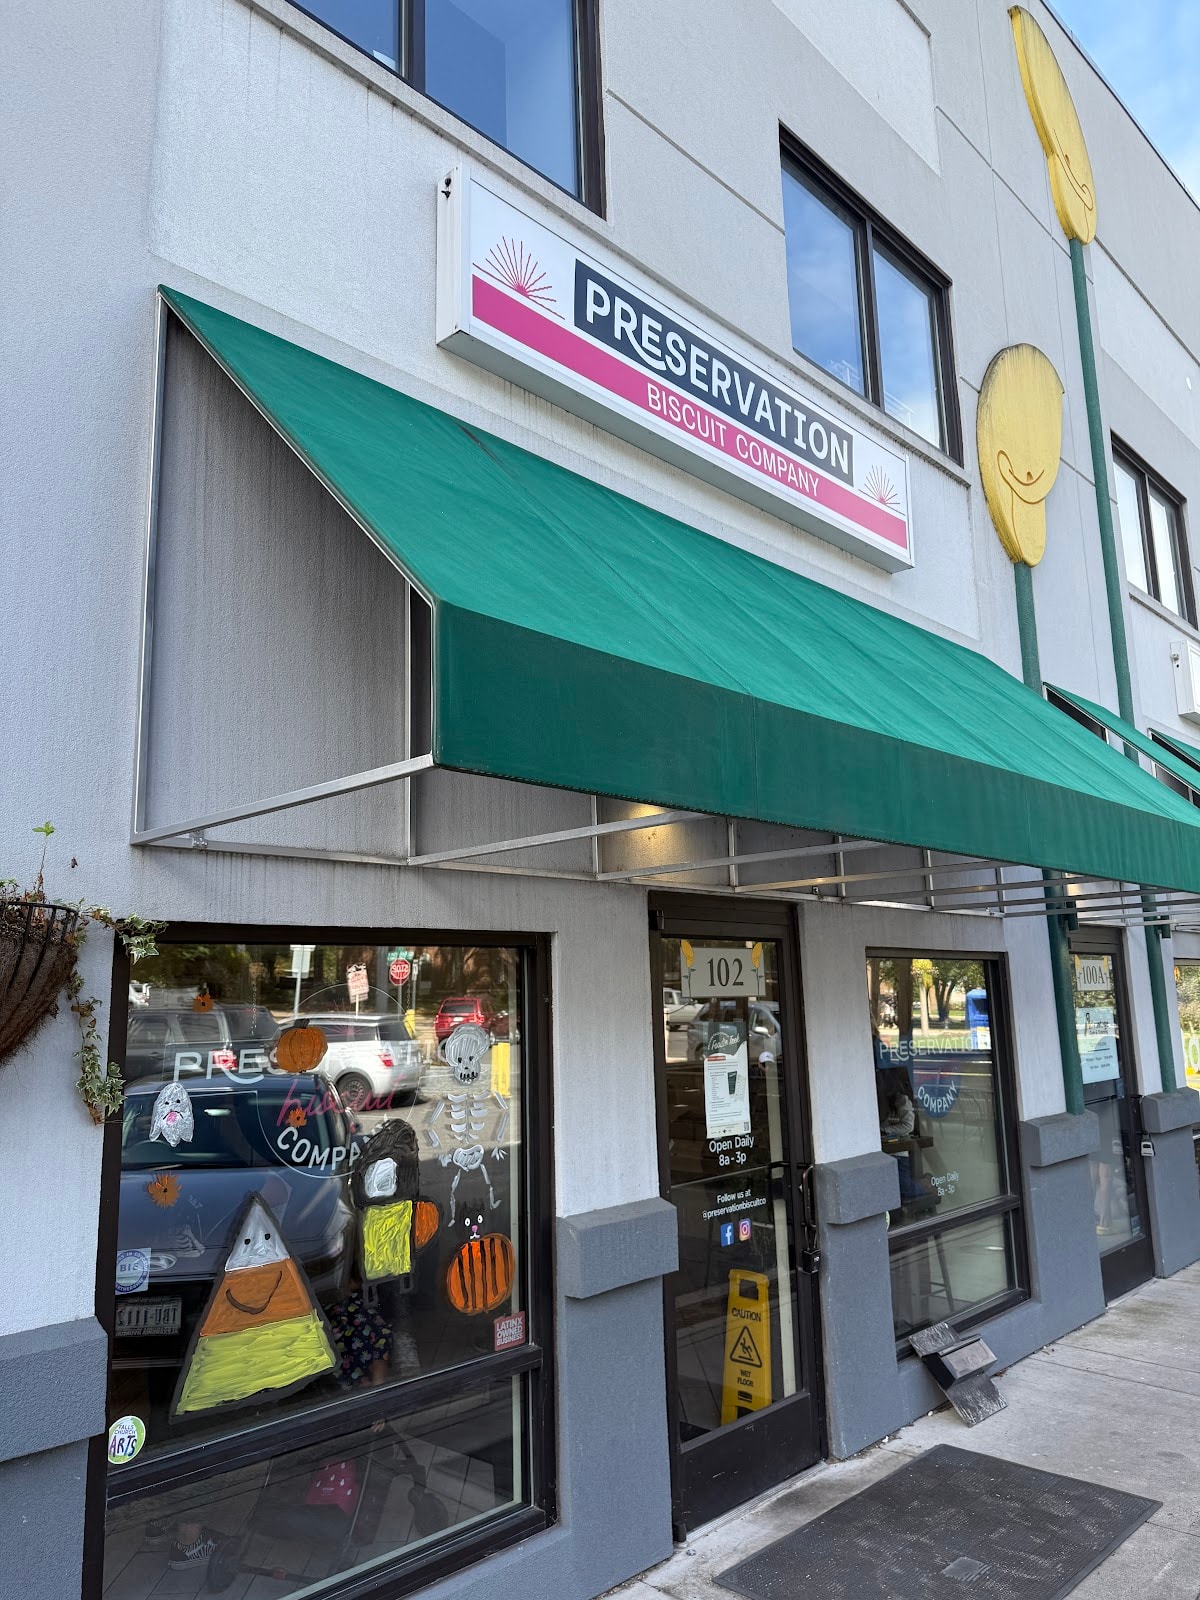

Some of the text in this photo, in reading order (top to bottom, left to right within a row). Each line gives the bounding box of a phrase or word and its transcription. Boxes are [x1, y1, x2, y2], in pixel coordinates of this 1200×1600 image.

[585, 279, 850, 475] PRESERVATION
[646, 382, 820, 497] BISCUIT COMPANY
[707, 957, 744, 987] 102
[1082, 965, 1105, 984] 100A
[917, 1080, 958, 1113] COMPANY
[709, 1134, 755, 1153] Open Daily
[719, 1154, 730, 1167] 8a
[735, 1152, 747, 1165] 3p
[931, 1176, 946, 1187] Open
[717, 1189, 752, 1204] Follow us at
[703, 1197, 767, 1220] @preservationbiscuitco
[732, 1307, 761, 1321] CAUTION
[496, 1316, 523, 1331] LATINX
[496, 1325, 523, 1339] OWNED
[496, 1333, 523, 1346] BUSINESS
[740, 1369, 751, 1378] WET
[737, 1377, 754, 1387] FLOOR
[109, 1435, 137, 1457] ARTS
